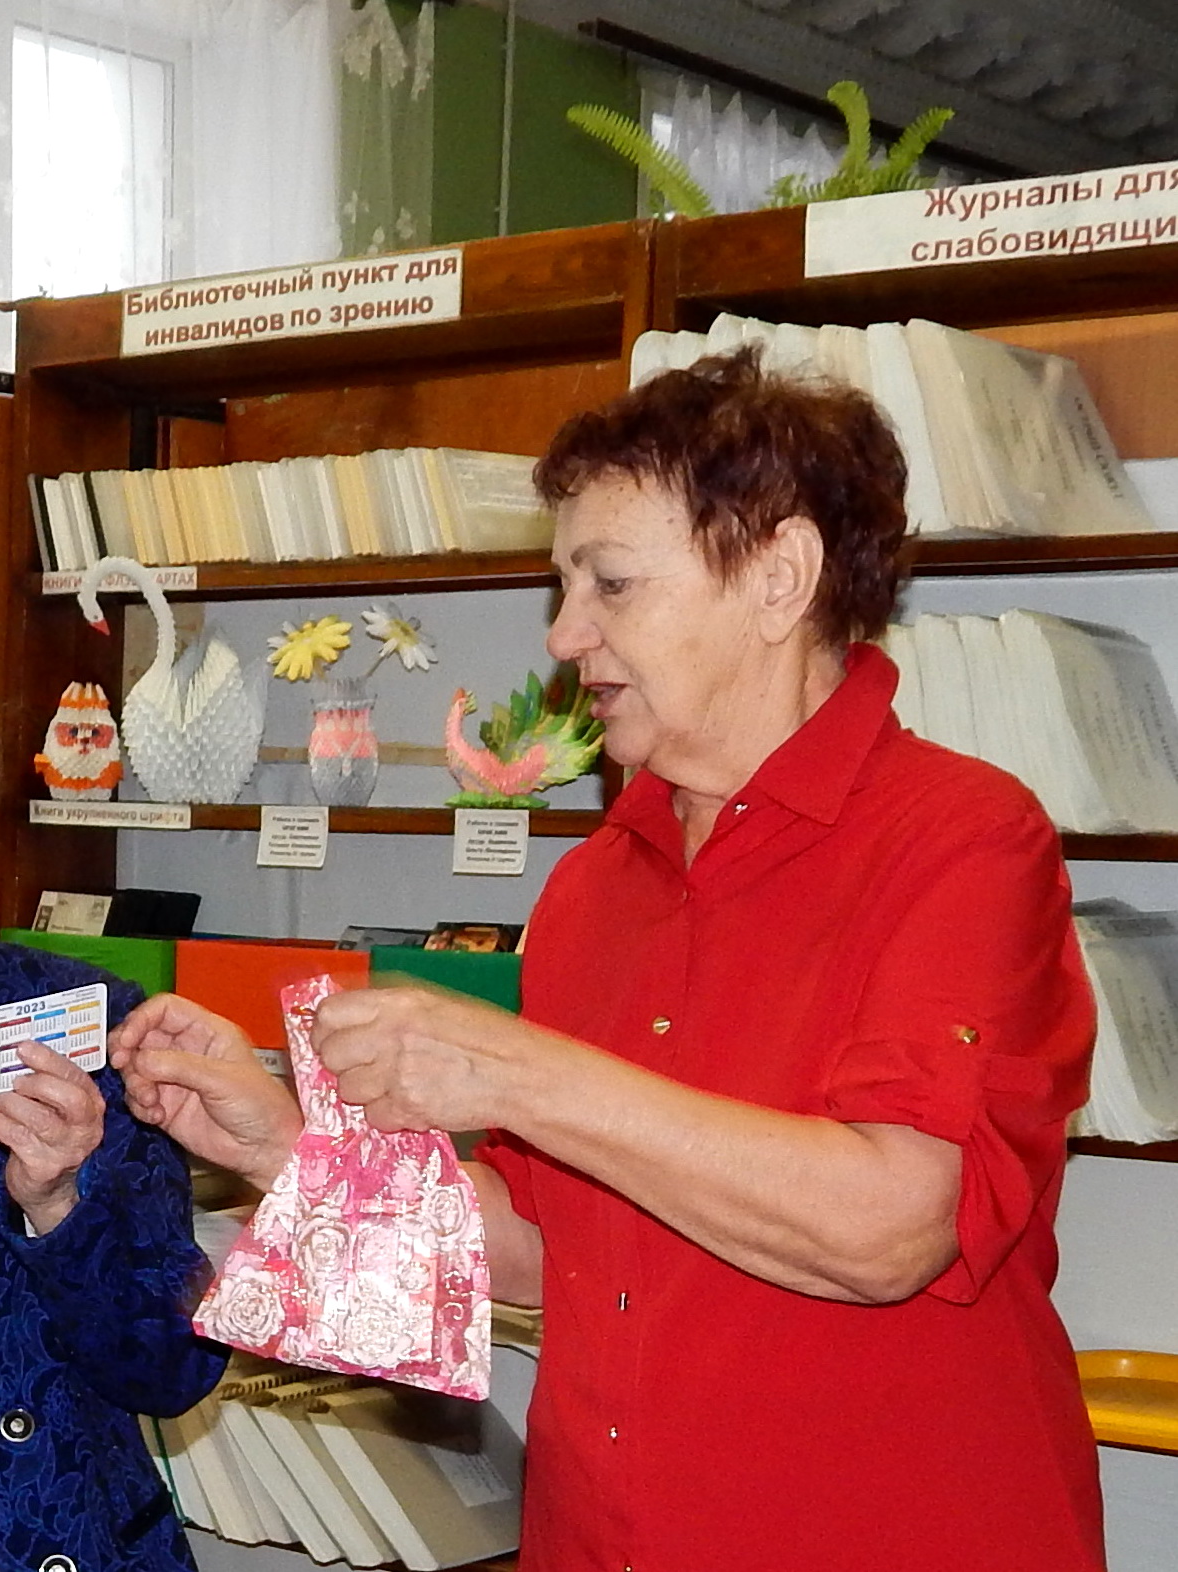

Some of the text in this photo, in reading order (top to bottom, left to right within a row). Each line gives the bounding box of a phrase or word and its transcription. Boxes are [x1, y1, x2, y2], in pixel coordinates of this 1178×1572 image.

[924, 178, 1103, 222] Журналы
[126, 256, 458, 316] Библиотечный пункт для
[145, 294, 434, 347] инвалидов по зрению
[15, 1000, 47, 1015] 2023
